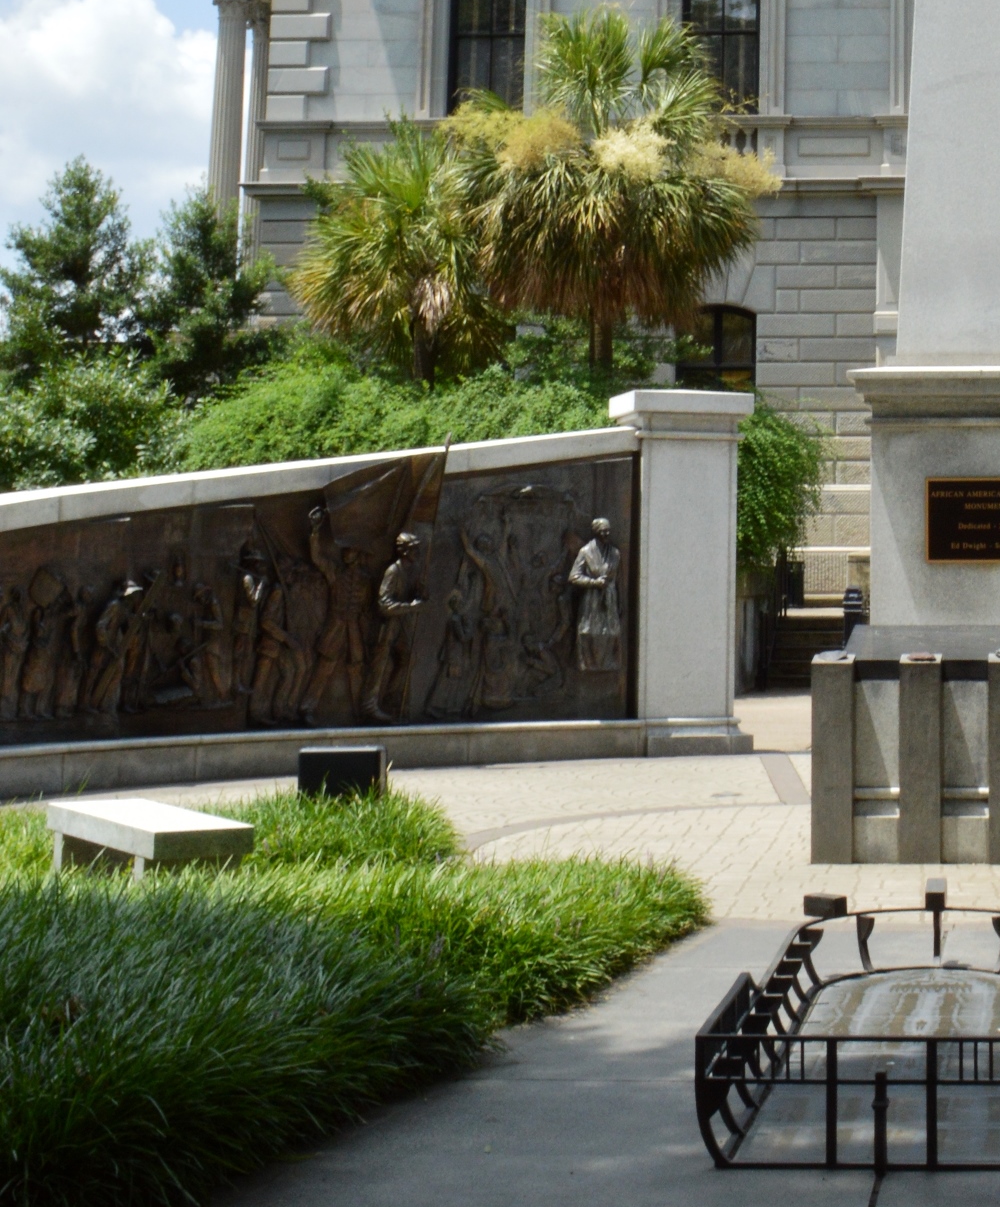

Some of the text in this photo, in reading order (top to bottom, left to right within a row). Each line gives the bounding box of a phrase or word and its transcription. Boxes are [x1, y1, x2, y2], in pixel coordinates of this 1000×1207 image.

[931, 490, 964, 498] AFRICAN
[958, 522, 991, 530] Dedicated
[962, 542, 986, 550] Dwight
